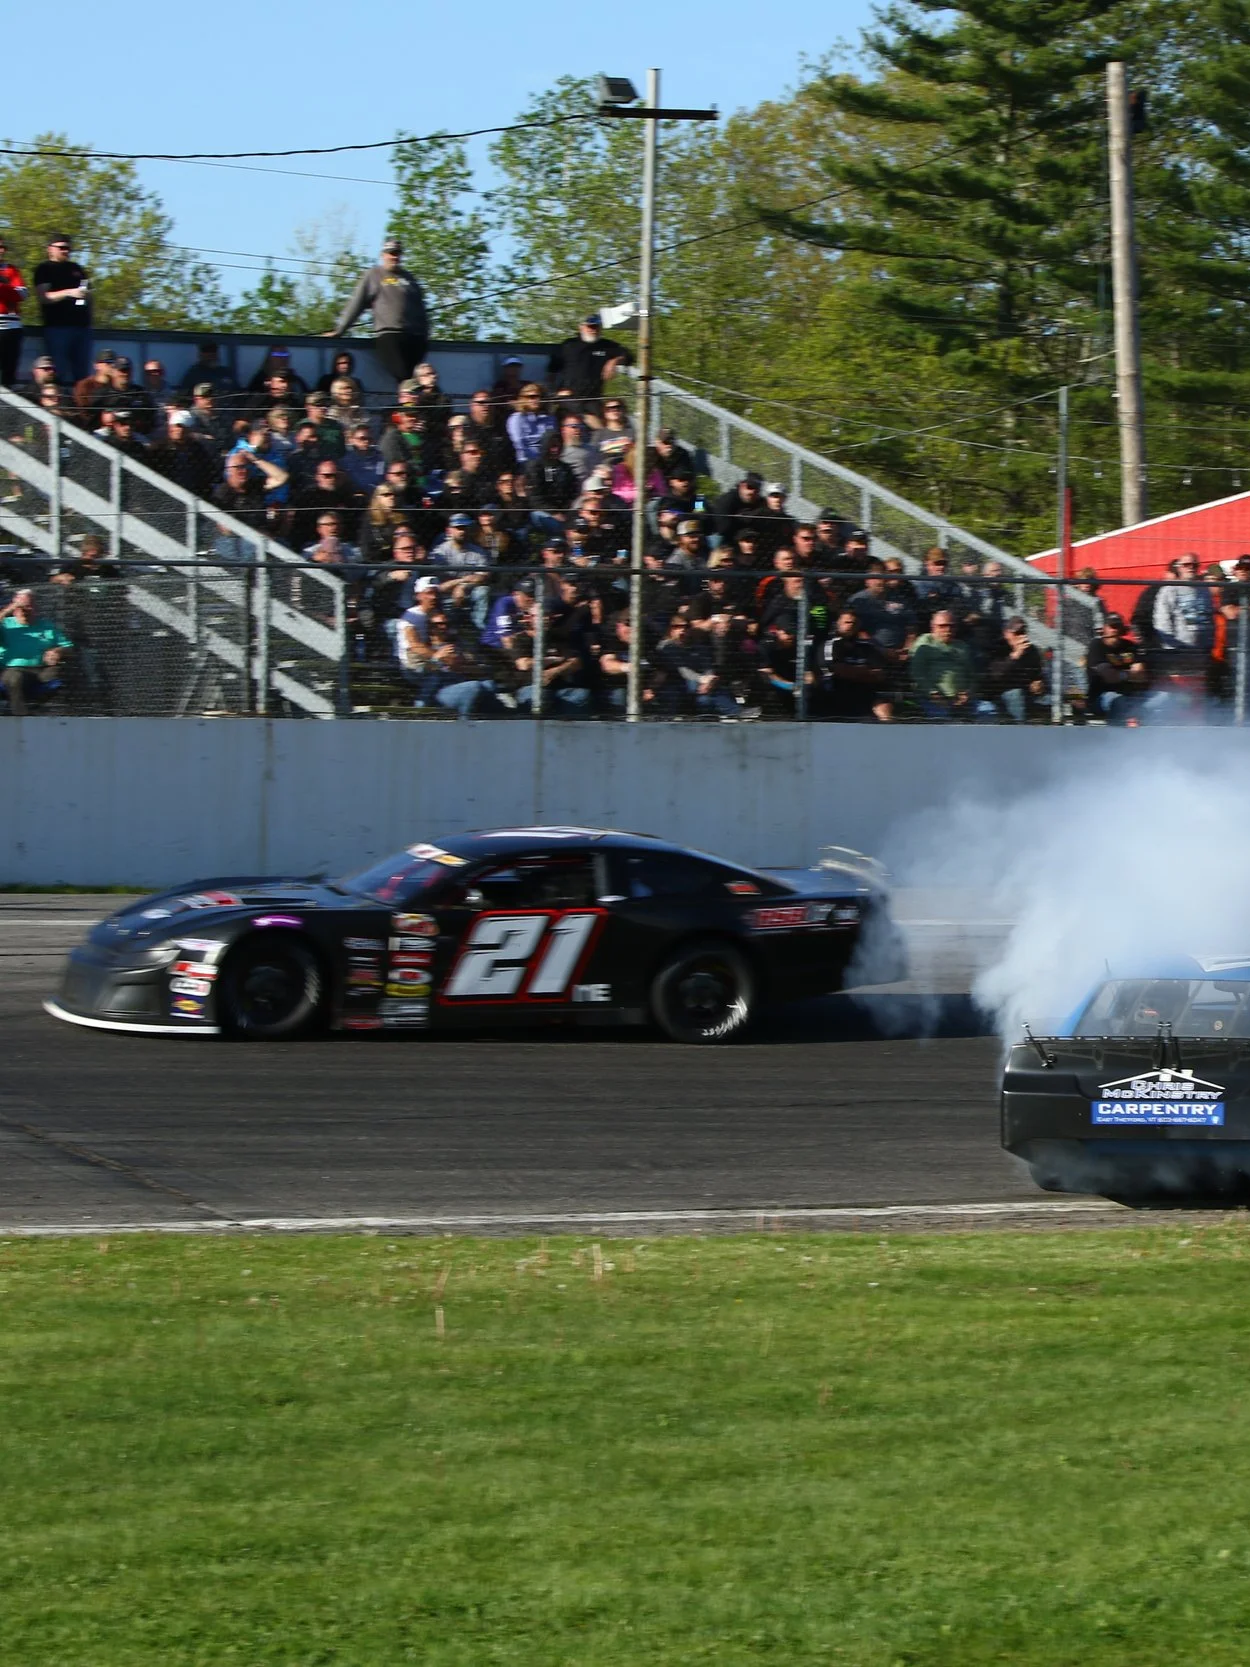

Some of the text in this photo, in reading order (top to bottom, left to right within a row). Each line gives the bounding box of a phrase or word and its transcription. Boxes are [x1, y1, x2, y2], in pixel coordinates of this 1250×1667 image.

[443, 914, 598, 996] 21
[1131, 1080, 1195, 1091] CHRIS
[1098, 1103, 1217, 1115] CARPENTRY
